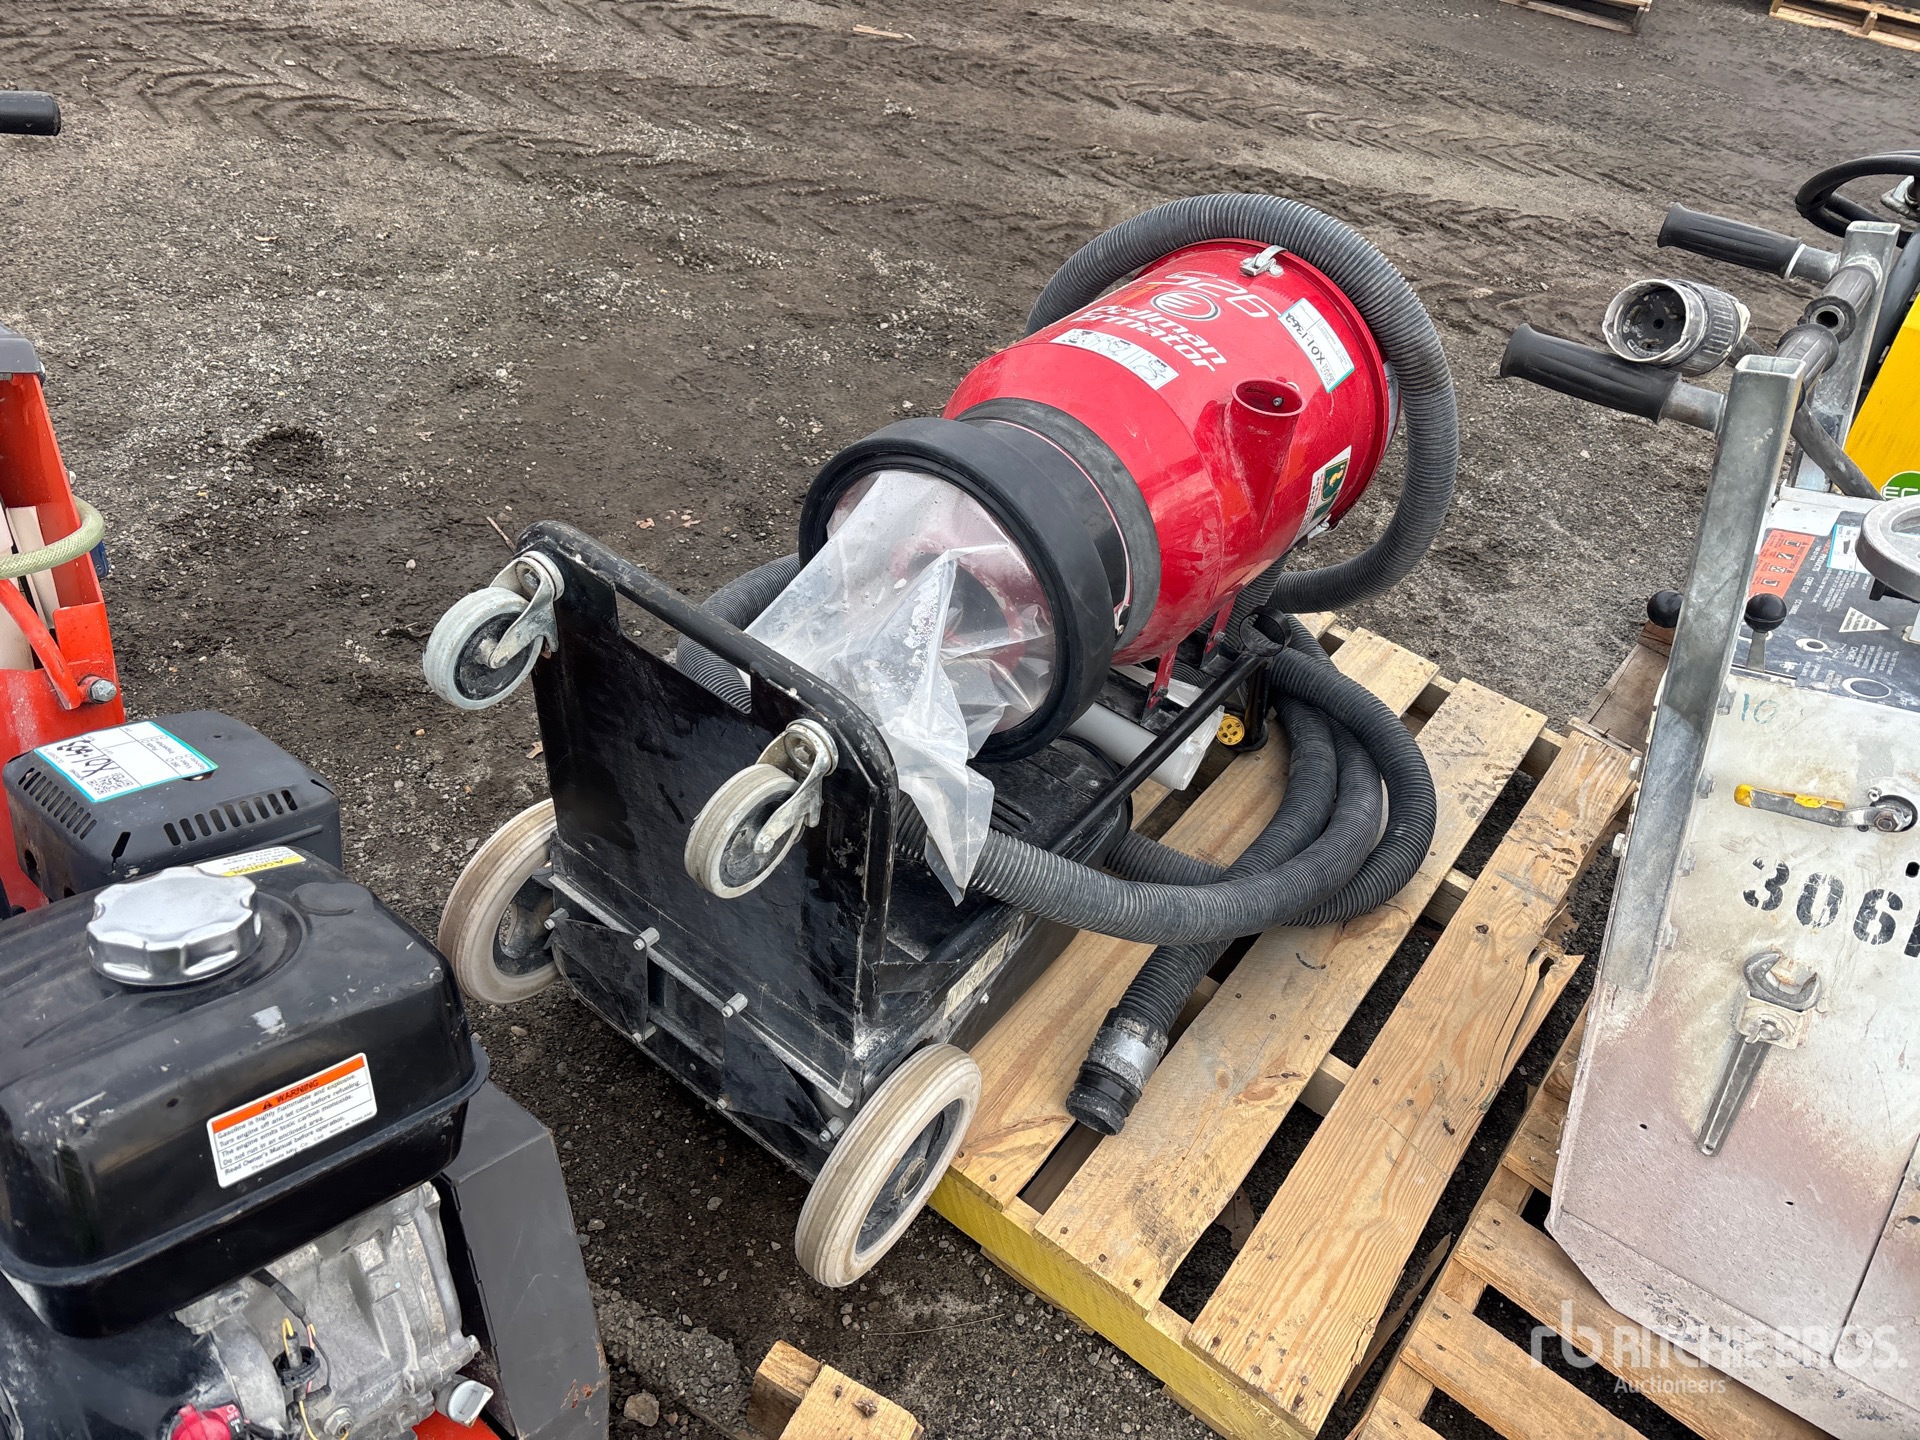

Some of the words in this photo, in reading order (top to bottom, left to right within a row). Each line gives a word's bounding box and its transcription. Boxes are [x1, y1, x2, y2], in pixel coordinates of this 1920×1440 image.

[1811, 551, 1826, 573] PRODUCTS
[1803, 575, 1814, 587] CORE
[1844, 646, 1859, 661] CHOKE
[1741, 693, 1777, 724] 10
[276, 1079, 319, 1102] WARNING
[217, 1123, 246, 1139] Gasoline
[255, 1109, 275, 1123] highly
[276, 1093, 311, 1112] flammable
[313, 1087, 325, 1095] and
[219, 1137, 234, 1147] Turn
[235, 1126, 258, 1140] engine
[271, 1114, 283, 1123] and
[295, 1103, 309, 1112] cool
[310, 1093, 331, 1105] before
[221, 1148, 234, 1156] The
[235, 1137, 258, 1151] engine
[260, 1128, 278, 1139] emits
[279, 1120, 295, 1130] toxic
[297, 1109, 320, 1122] carbon
[233, 1152, 244, 1160] not
[246, 1146, 258, 1154] run
[277, 1123, 307, 1140] enclosed
[224, 1163, 241, 1174] Read
[242, 1151, 268, 1166] Owner's
[269, 1139, 292, 1153] Manual
[293, 1130, 313, 1142] before
